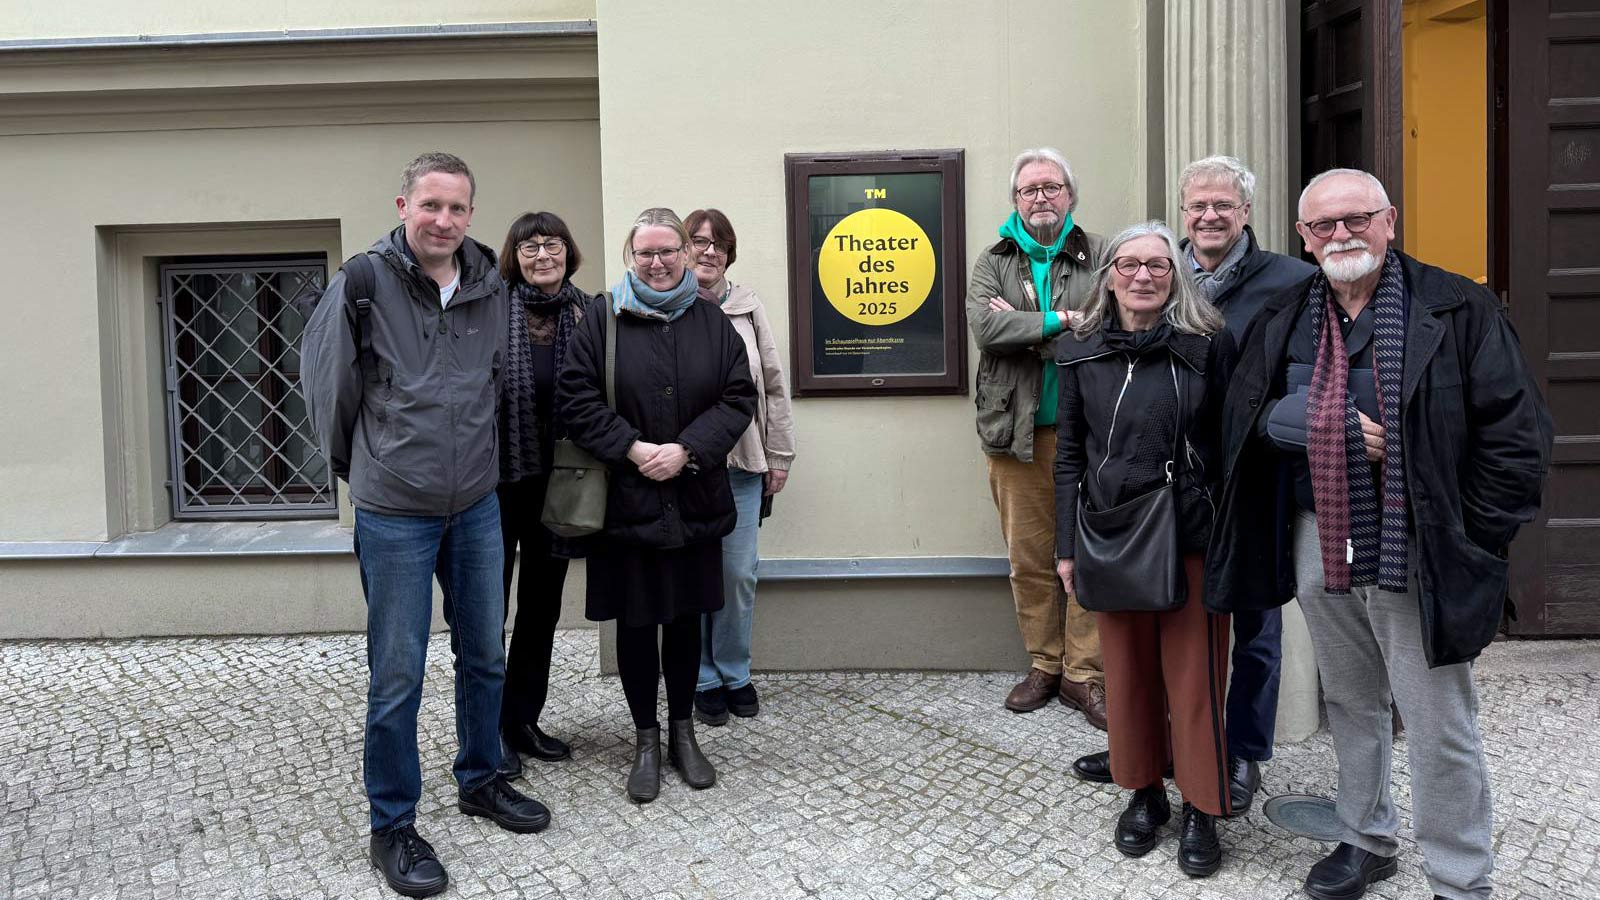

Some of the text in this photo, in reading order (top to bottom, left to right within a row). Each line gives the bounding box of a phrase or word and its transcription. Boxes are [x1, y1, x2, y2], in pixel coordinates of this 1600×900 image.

[864, 188, 886, 199] TM
[834, 234, 918, 252] Theater
[859, 255, 895, 273] des
[845, 277, 909, 298] Jahres
[858, 302, 897, 315] 2025
